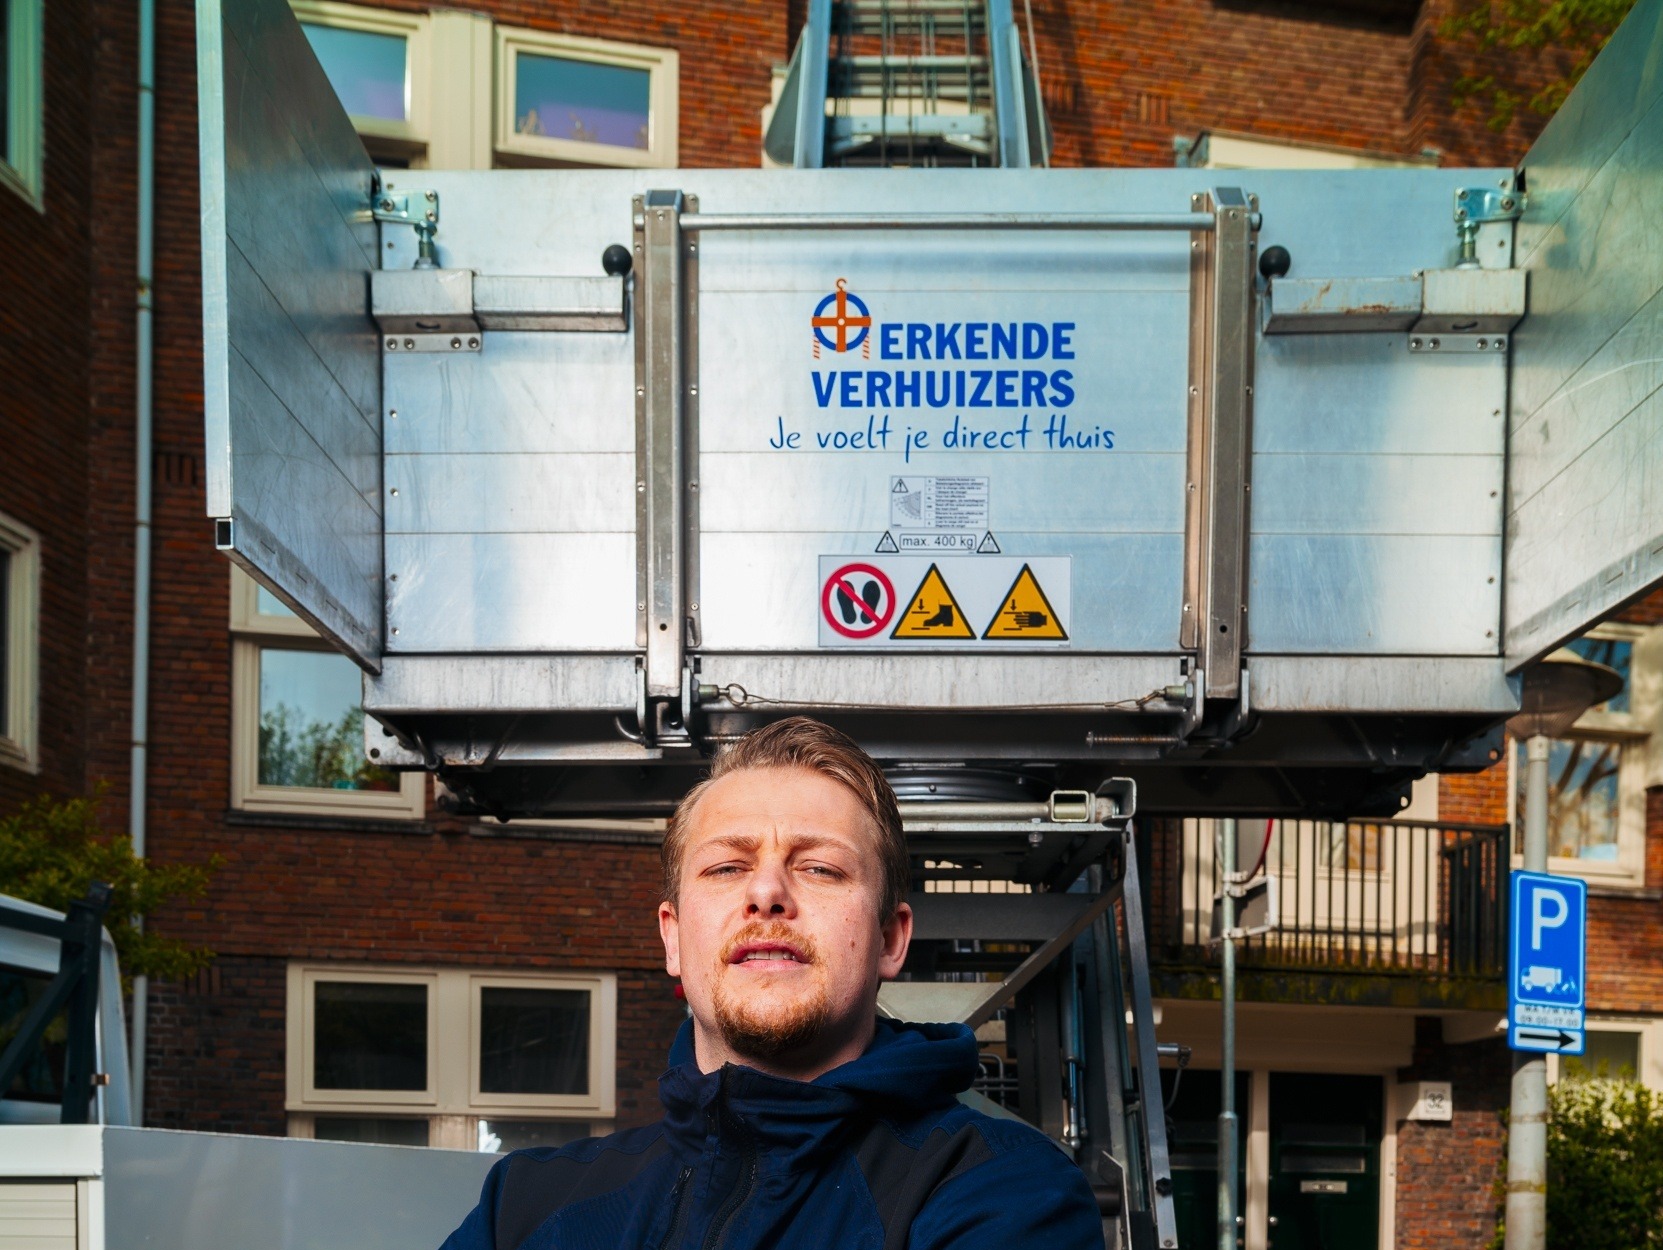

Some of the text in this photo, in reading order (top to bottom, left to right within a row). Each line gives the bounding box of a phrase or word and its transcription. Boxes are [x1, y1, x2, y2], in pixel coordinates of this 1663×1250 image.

[880, 322, 1075, 360] ERKENDE
[811, 369, 1075, 408] VERHUIZERS
[769, 414, 1115, 463] Je voelt je direct thuis
[902, 535, 974, 549] max. 400 kg
[1532, 888, 1568, 950] P
[1427, 1092, 1445, 1109] 32
